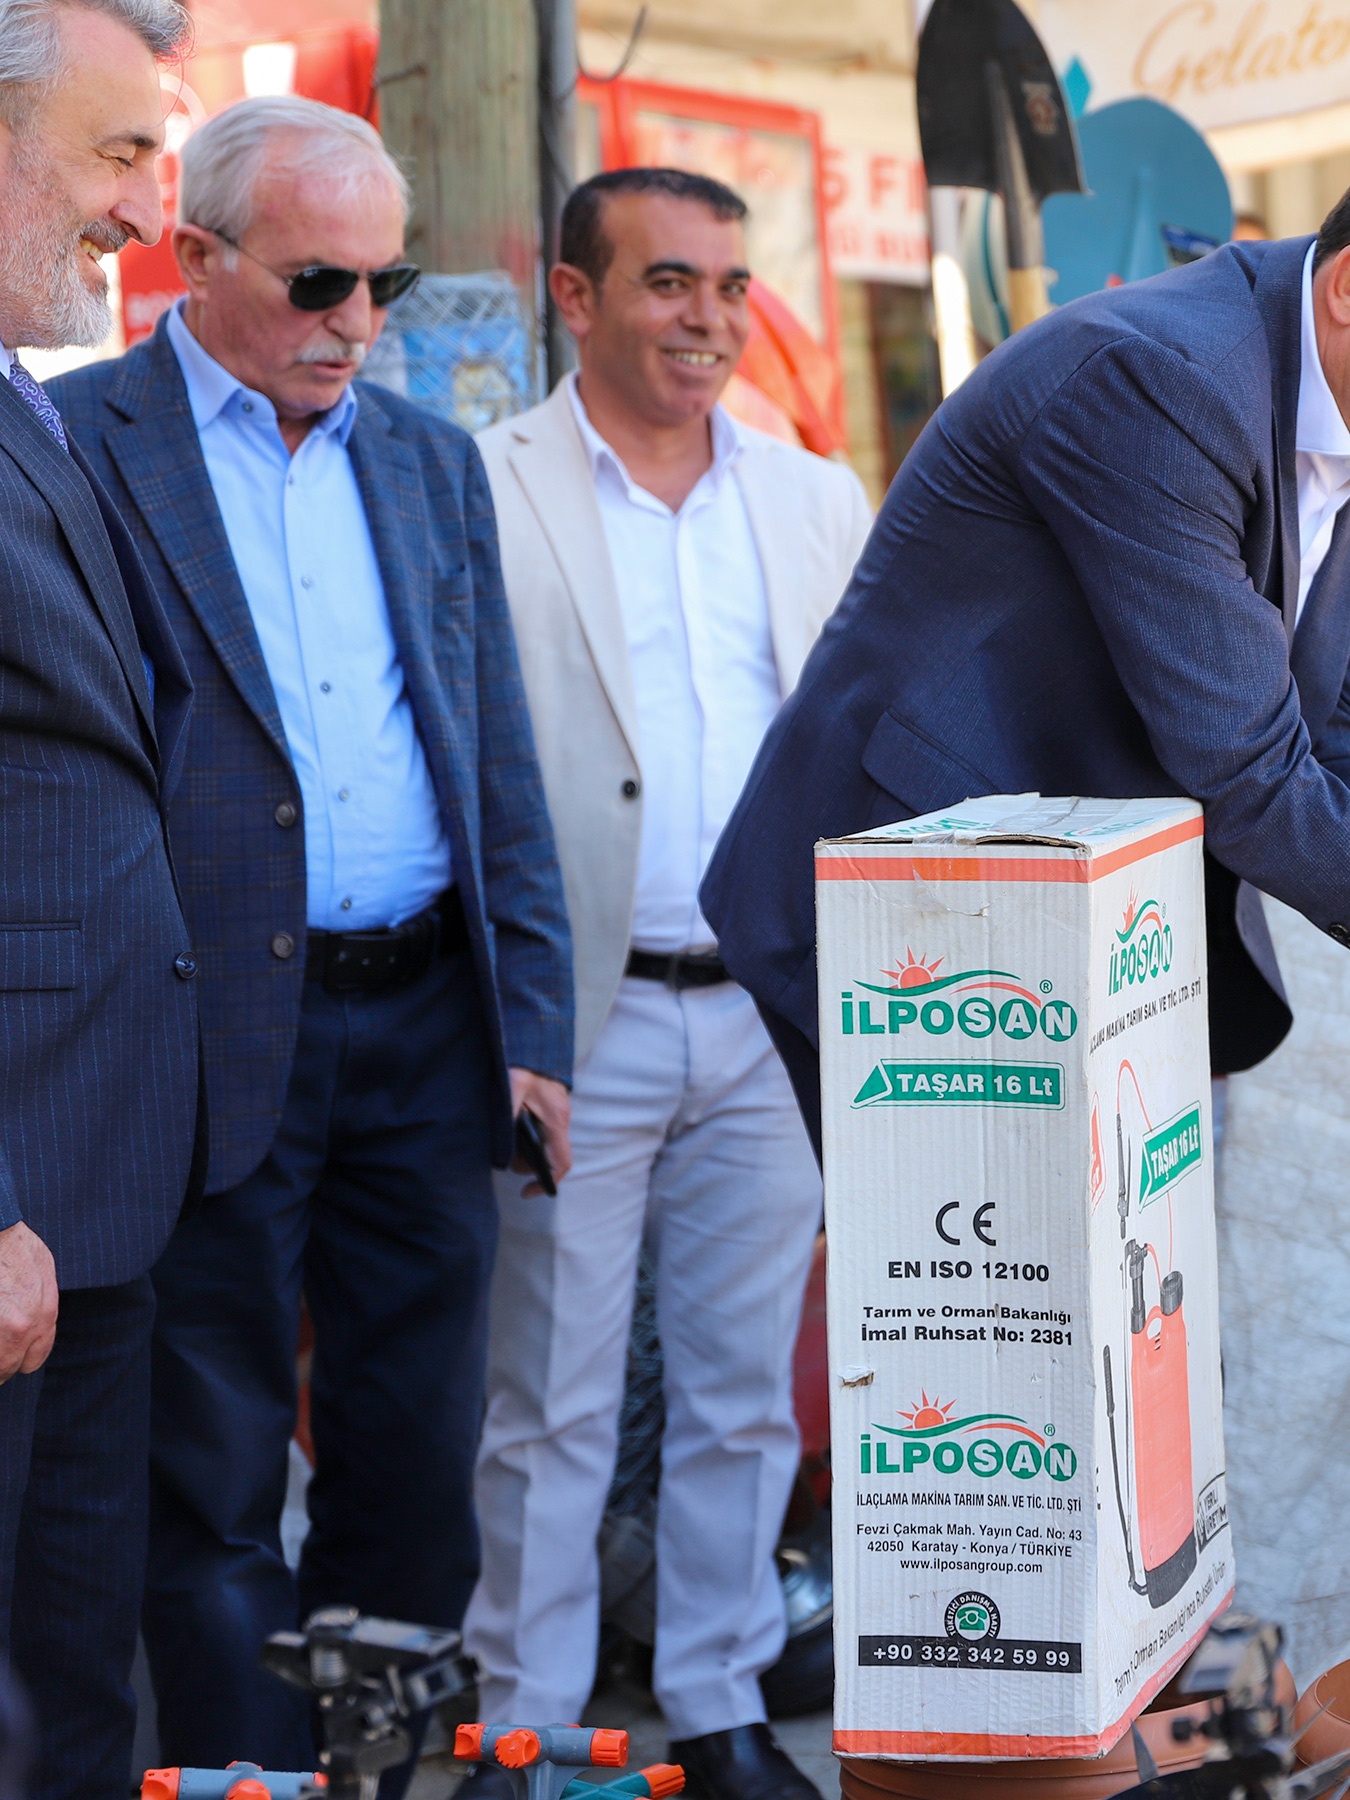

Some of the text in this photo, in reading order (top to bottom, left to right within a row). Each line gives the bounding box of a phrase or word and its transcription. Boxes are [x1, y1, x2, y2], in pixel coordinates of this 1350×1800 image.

[1108, 924, 1173, 996] İLPOSAN
[841, 991, 1078, 1042] İLPOSAN
[896, 1073, 1053, 1099] TAŞAR 16 Lt
[1150, 1124, 1199, 1181] TAŞAR 16 Lt
[935, 1201, 997, 1246] CE
[888, 1260, 1050, 1283] EN ISO 12100
[863, 1305, 1072, 1326] Tarım ve Orman Bakanlığı
[861, 1323, 1073, 1346] İmal Ruhsat No: 2381
[860, 1434, 1078, 1482] İLPOSAN
[856, 1490, 1082, 1515] İLAÇLAMA MAKİNA TARIM SAN. VE TİC. LTD. ŞTİ
[856, 1522, 1082, 1541] Fevzi Çakmak Mah. Yayın Cad. No: 43
[867, 1541, 904, 1552] 42050
[912, 1541, 959, 1556] Karatay
[970, 1542, 1009, 1557] Konya
[1011, 1543, 1017, 1555] /
[1020, 1541, 1073, 1558] TÜRKİYE
[900, 1558, 1043, 1574] www.ilposangroup.com
[873, 1644, 1070, 1667] +90 332 342 59 99
